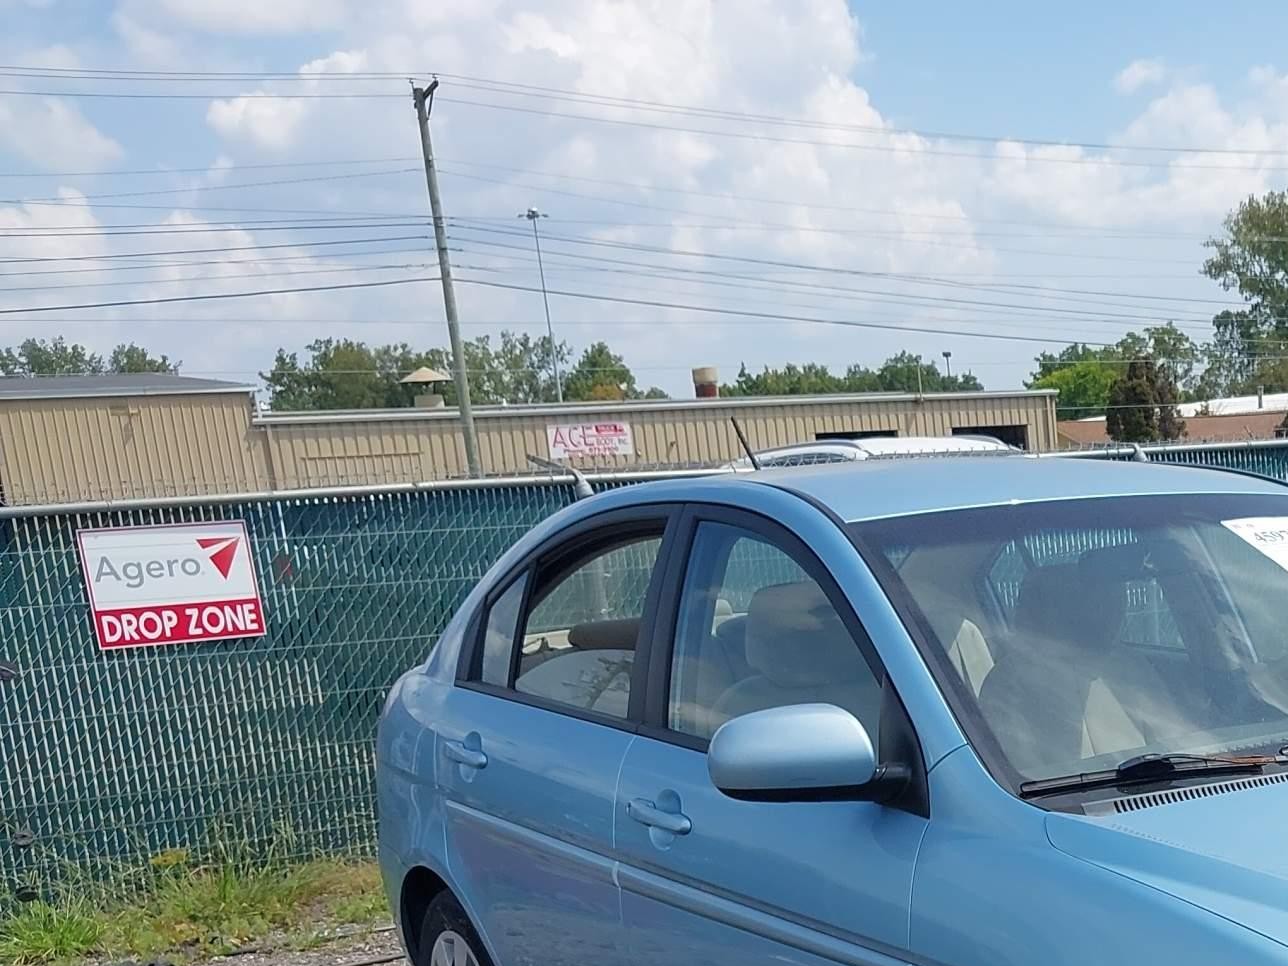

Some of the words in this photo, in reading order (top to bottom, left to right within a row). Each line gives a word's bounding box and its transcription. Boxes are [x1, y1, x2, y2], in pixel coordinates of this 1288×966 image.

[552, 425, 595, 448] ACE
[94, 555, 201, 588] Agero
[100, 611, 178, 643] DROP
[185, 603, 259, 636] ZONE
